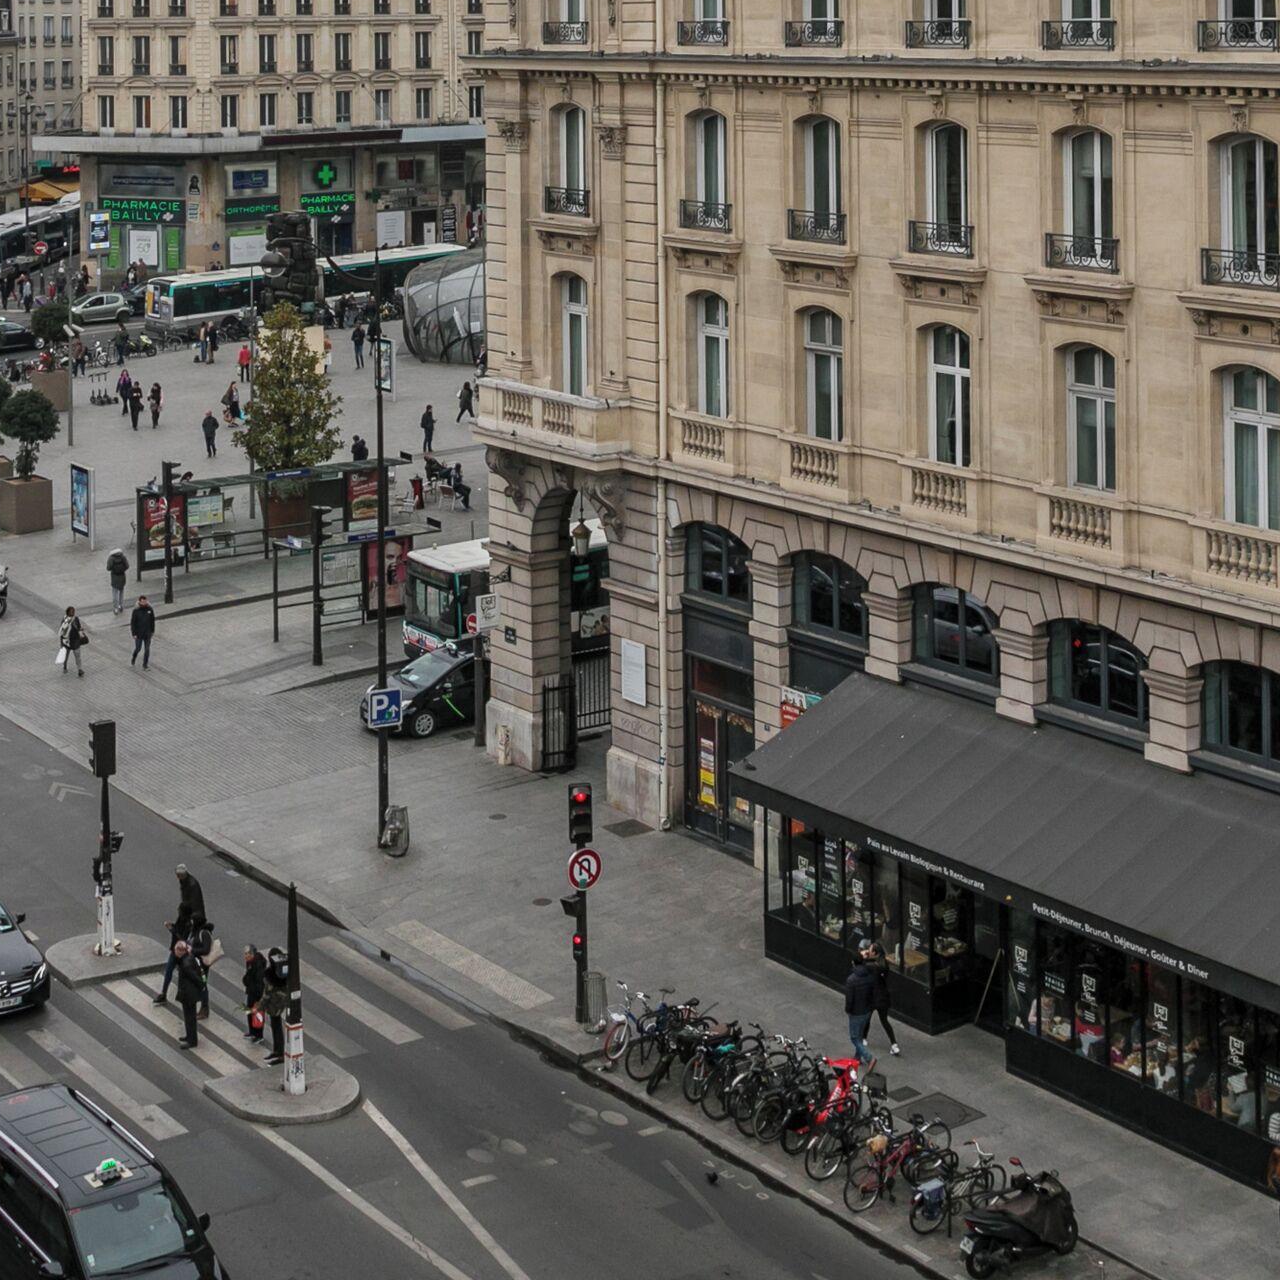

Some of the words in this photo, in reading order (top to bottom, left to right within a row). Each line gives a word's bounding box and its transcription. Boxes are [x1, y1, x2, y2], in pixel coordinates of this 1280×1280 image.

[103, 199, 181, 211] PHARMACIE
[301, 193, 356, 204] PHARMACIE
[372, 695, 389, 720] P
[866, 836, 881, 849] Pain
[881, 844, 890, 853] au
[889, 846, 910, 860] Levain
[910, 854, 943, 872] Biologique
[943, 866, 949, 876] &
[949, 869, 985, 891] Restaurant
[1032, 902, 1085, 932] Petit-Déjeuner,
[1084, 923, 1113, 943] Brunch,
[1113, 934, 1150, 957] Déjeuner,
[1150, 949, 1177, 967] Goûter
[1178, 960, 1186, 970] &
